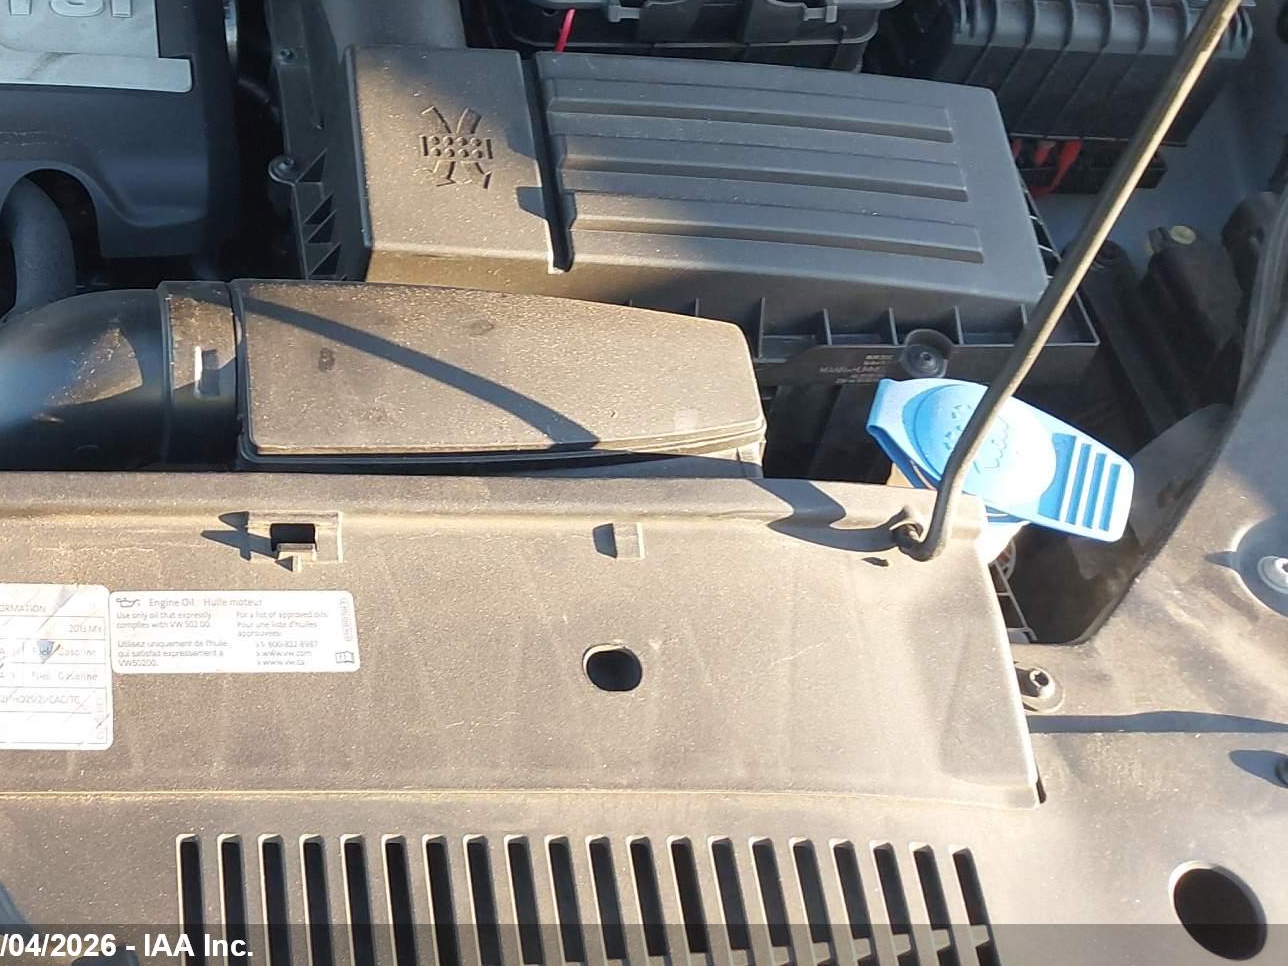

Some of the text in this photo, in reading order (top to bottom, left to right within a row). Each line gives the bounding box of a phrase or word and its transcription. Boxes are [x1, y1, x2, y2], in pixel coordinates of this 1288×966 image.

[148, 598, 180, 609] Engine
[181, 598, 195, 607] Oil
[229, 599, 263, 607] moteur
